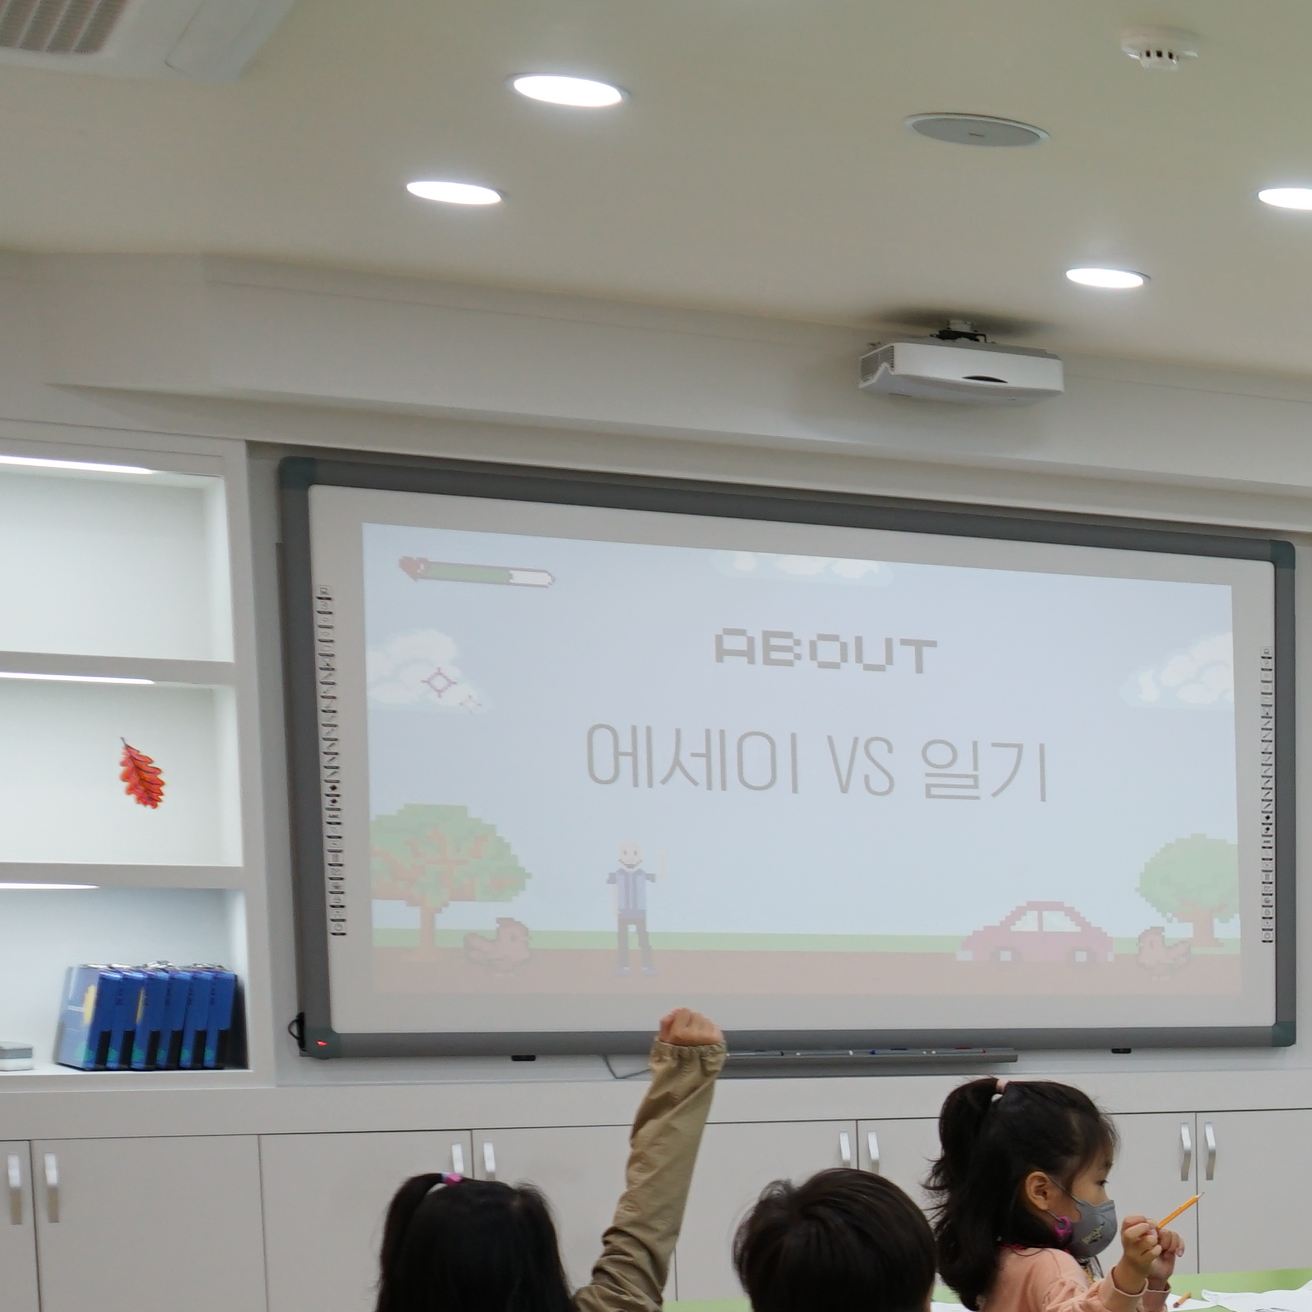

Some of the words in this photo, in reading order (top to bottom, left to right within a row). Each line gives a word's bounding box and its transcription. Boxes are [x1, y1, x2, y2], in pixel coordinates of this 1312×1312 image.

[714, 627, 938, 674] ABOUT
[586, 722, 800, 795] 에세이
[826, 734, 896, 796] VS
[920, 738, 1047, 803] 일기
